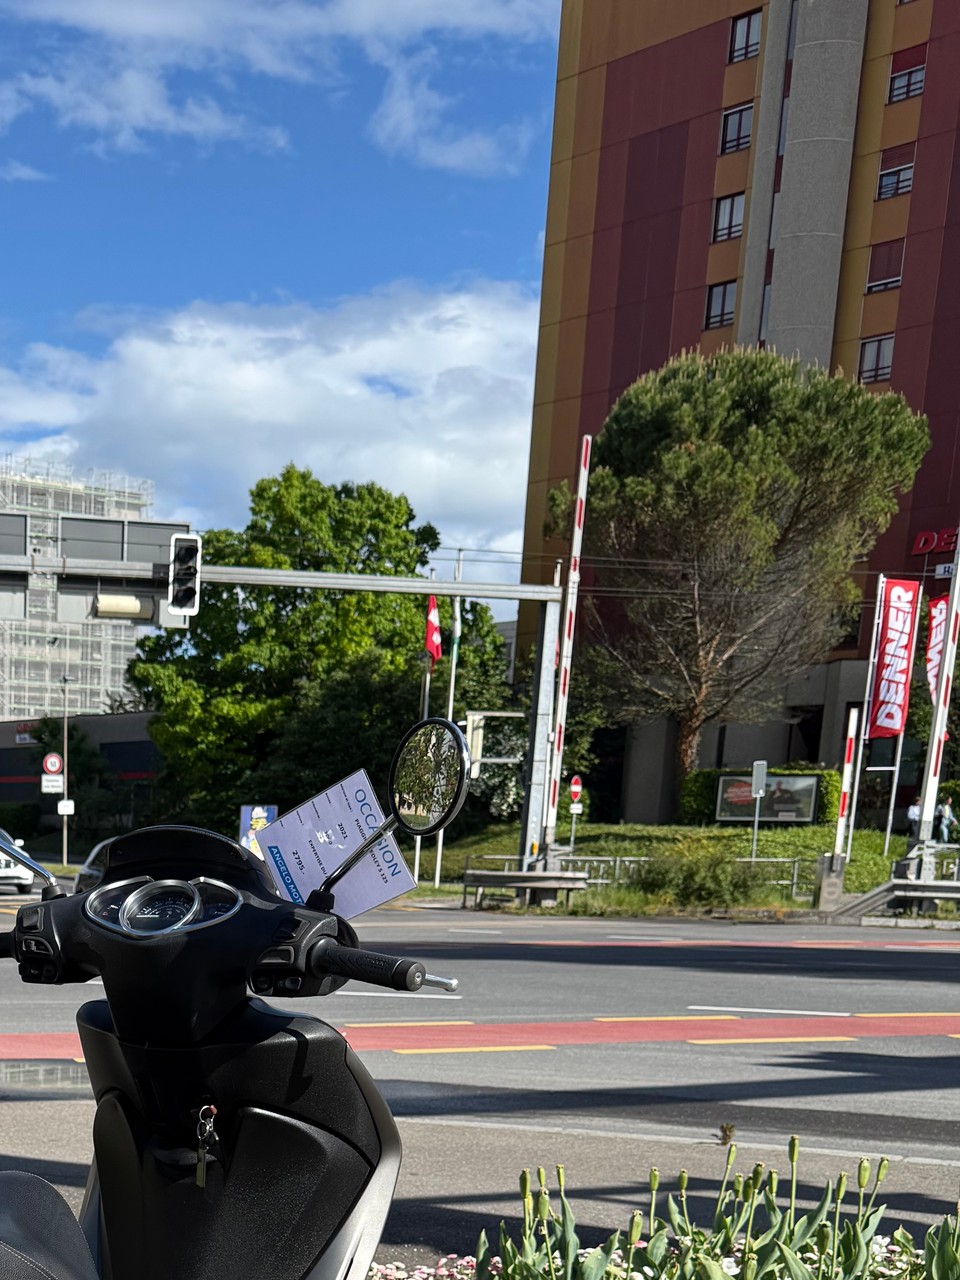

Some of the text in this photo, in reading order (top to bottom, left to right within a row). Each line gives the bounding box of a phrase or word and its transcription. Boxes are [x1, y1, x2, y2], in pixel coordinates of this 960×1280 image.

[876, 585, 914, 730] DENNER
[337, 823, 348, 840] 2021
[354, 819, 368, 843] PIAGGI
[369, 850, 381, 869] EDLEY
[380, 873, 389, 884] 125
[271, 847, 302, 904] ANGELO MOT
